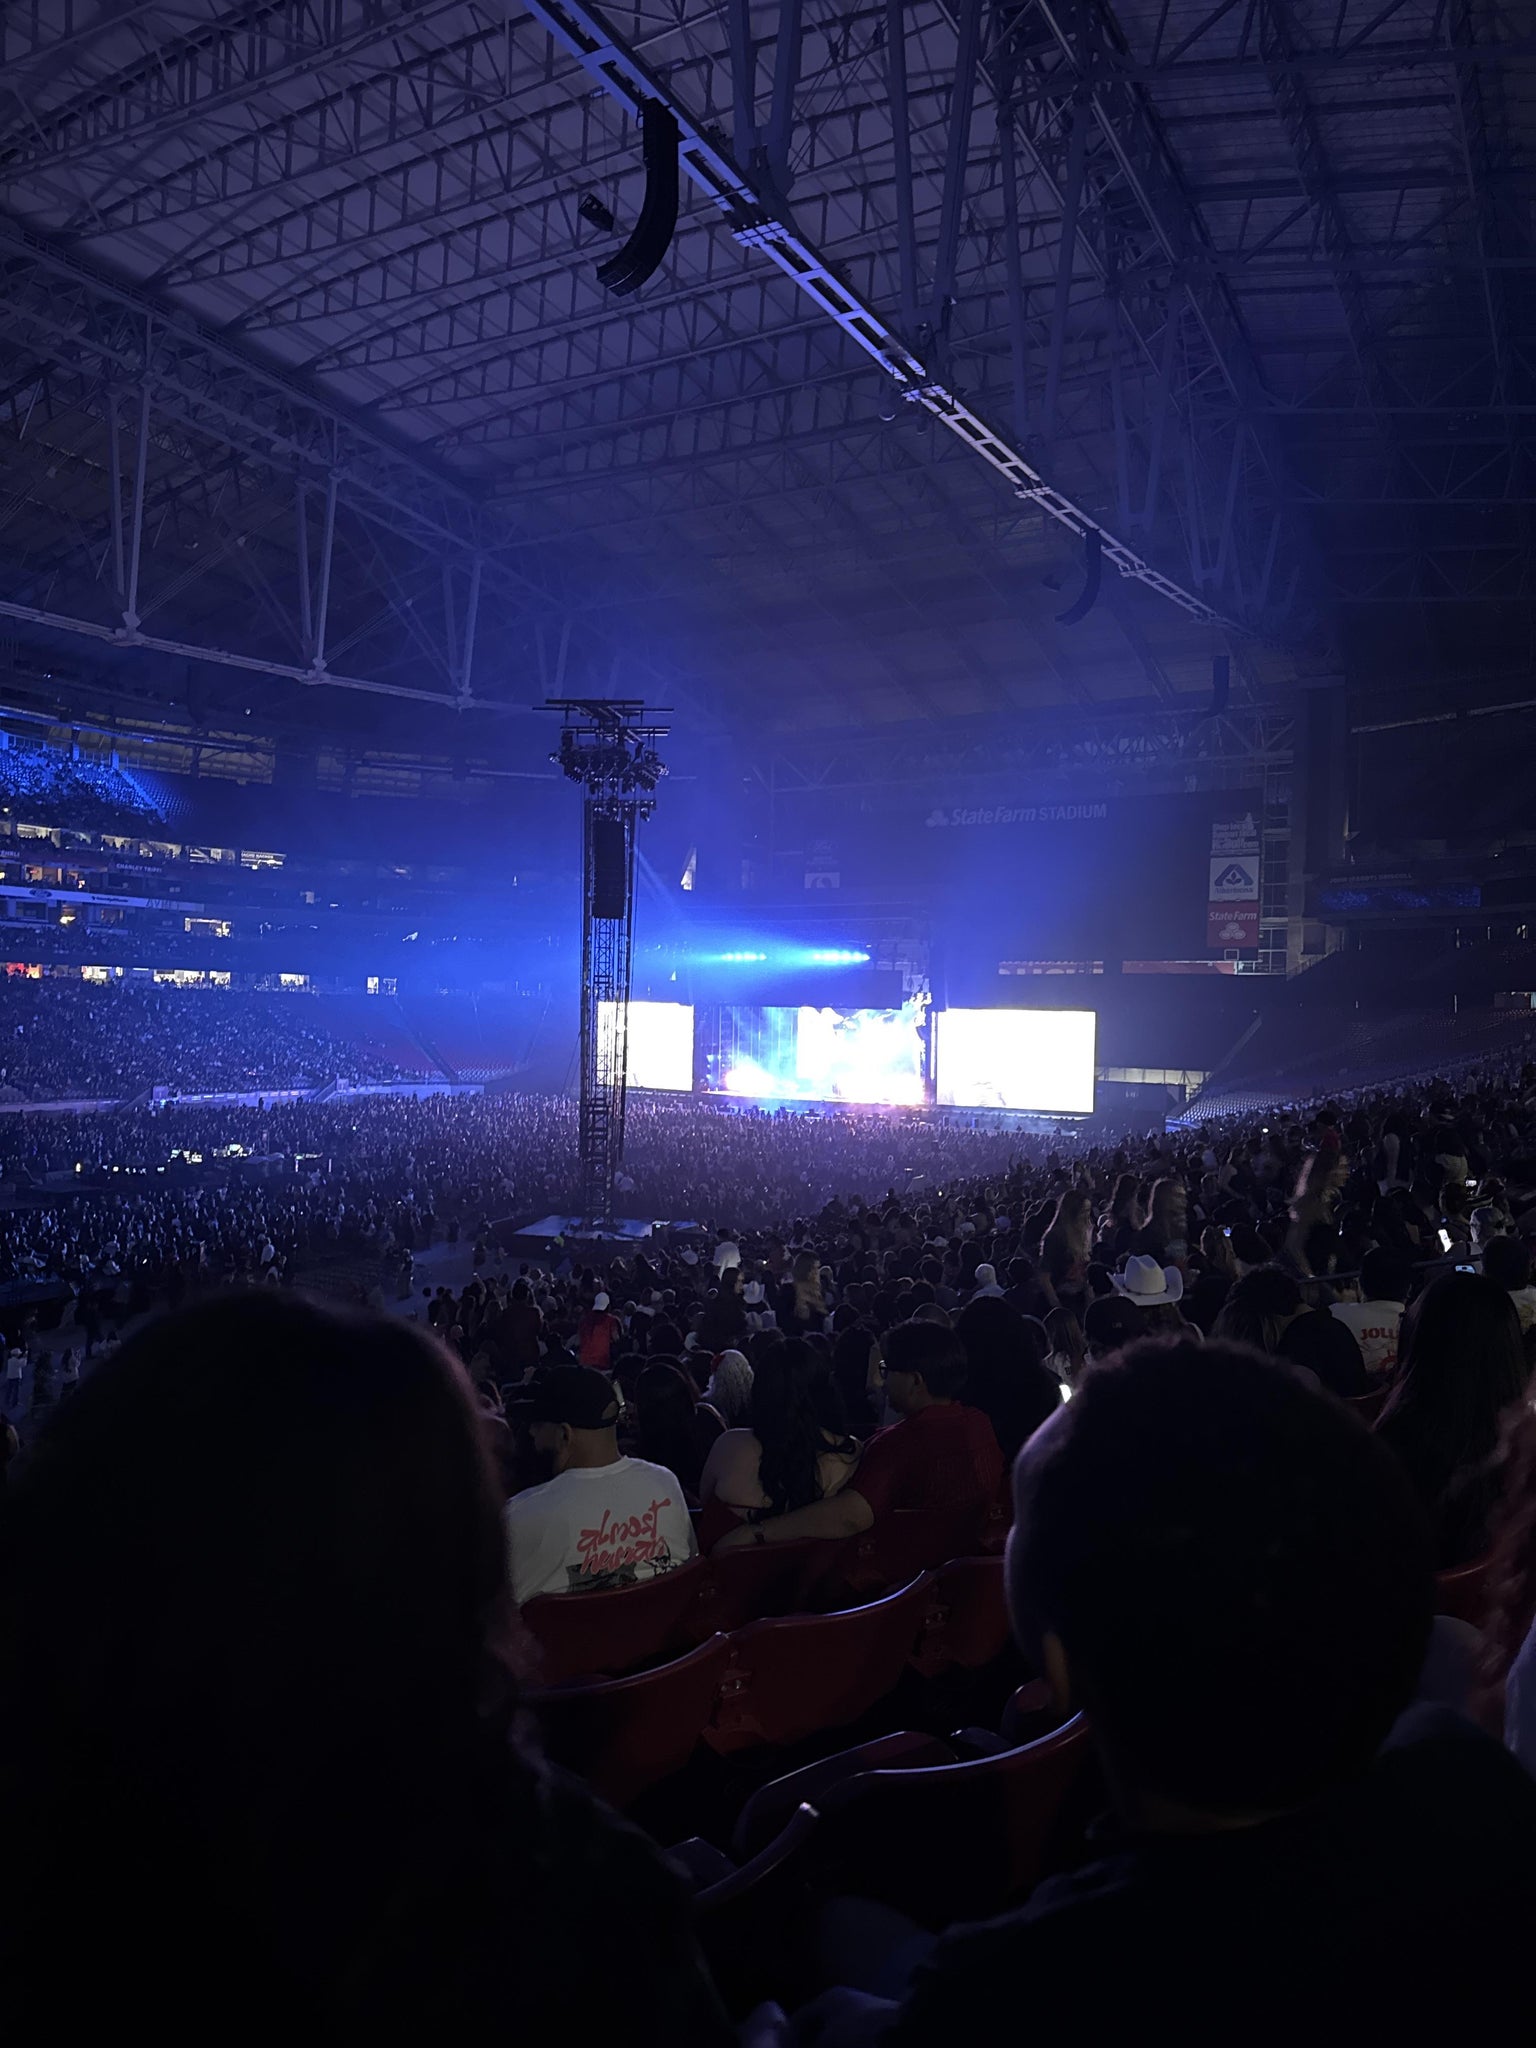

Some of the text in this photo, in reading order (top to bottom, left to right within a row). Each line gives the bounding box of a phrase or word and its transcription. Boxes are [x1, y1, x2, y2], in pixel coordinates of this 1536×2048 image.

[1039, 803, 1107, 821] STADIUM
[1361, 1327, 1399, 1340] JOLL
[577, 1498, 671, 1552] almost
